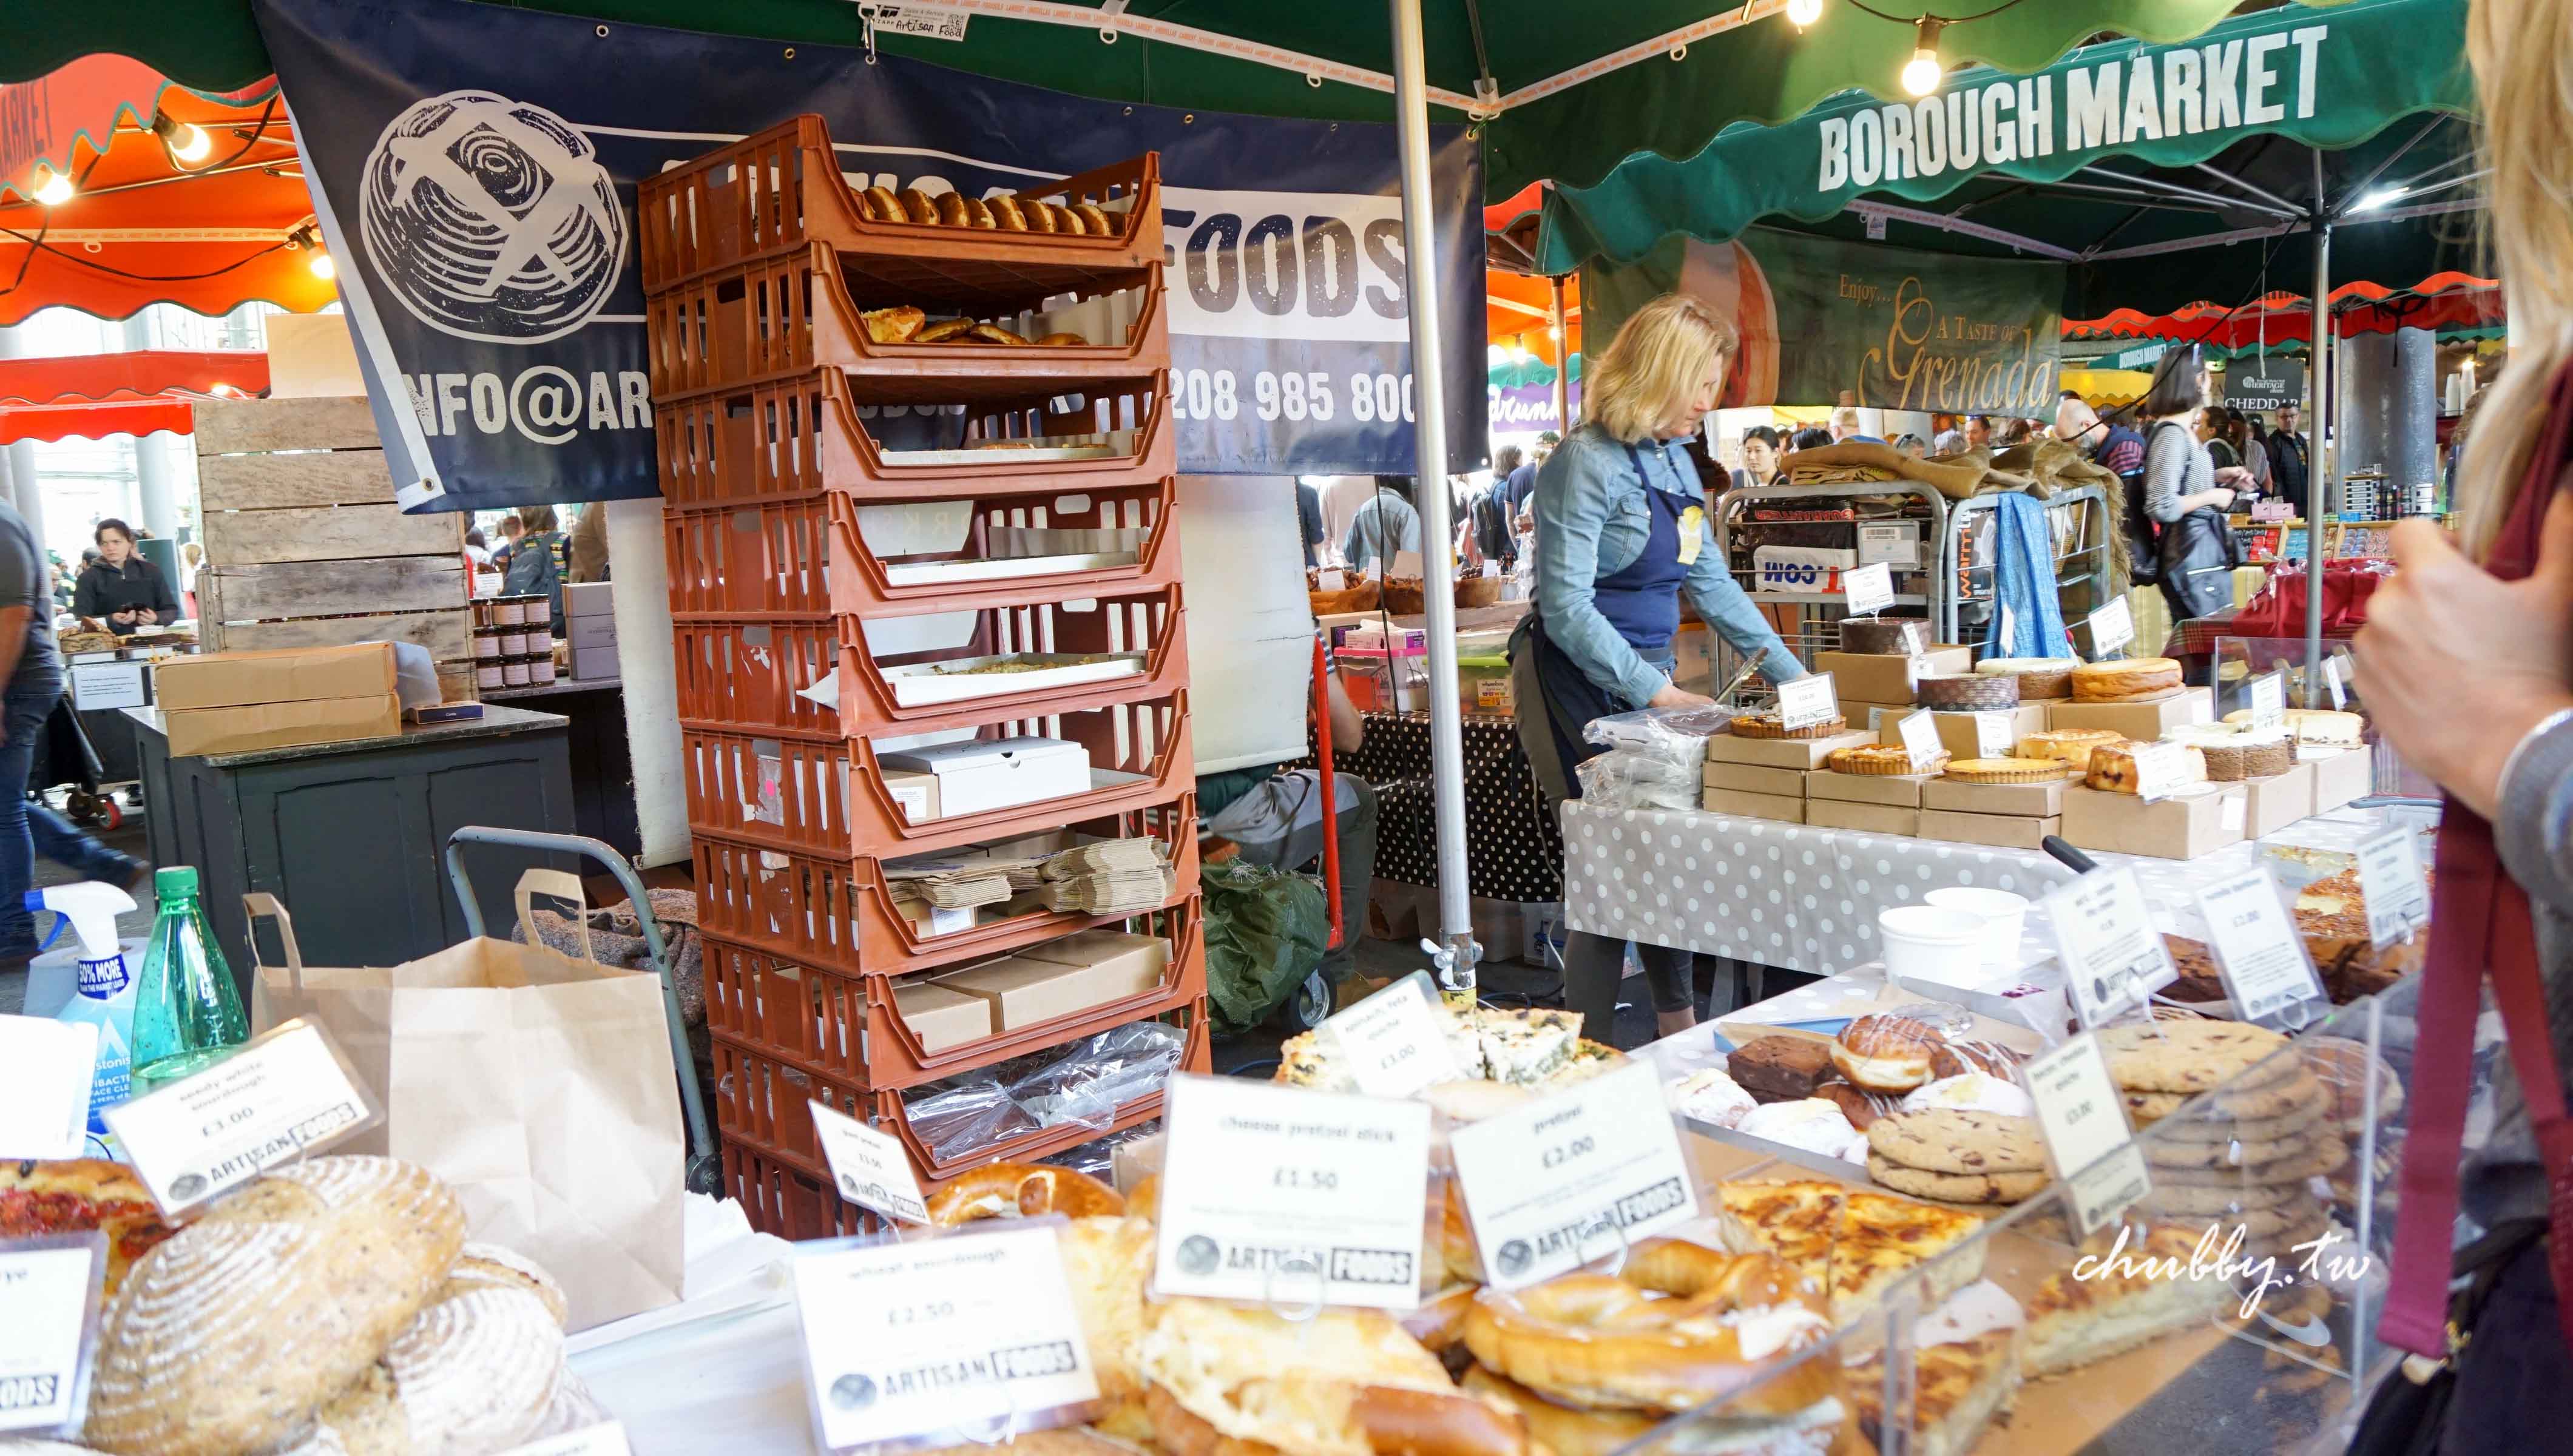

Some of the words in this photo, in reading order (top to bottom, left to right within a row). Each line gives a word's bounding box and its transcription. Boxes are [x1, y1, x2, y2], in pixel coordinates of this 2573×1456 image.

[895, 19, 935, 33] Artisan
[938, 24, 962, 38] Food
[1819, 74, 2053, 192] BOROUGH
[2065, 24, 2328, 152] MARKET
[1858, 276, 2053, 410] Grenada
[1936, 315, 1949, 340] A
[1255, 371, 1334, 421] 985
[1763, 561, 1846, 595] T.COM
[95, 958, 123, 983] MORE
[209, 1134, 291, 1183] ARTISAN
[1541, 1134, 1595, 1170] £2.00
[1273, 1165, 1339, 1190] £1.50
[888, 1301, 956, 1327] £2.50
[884, 1357, 988, 1397] ARTISAN
